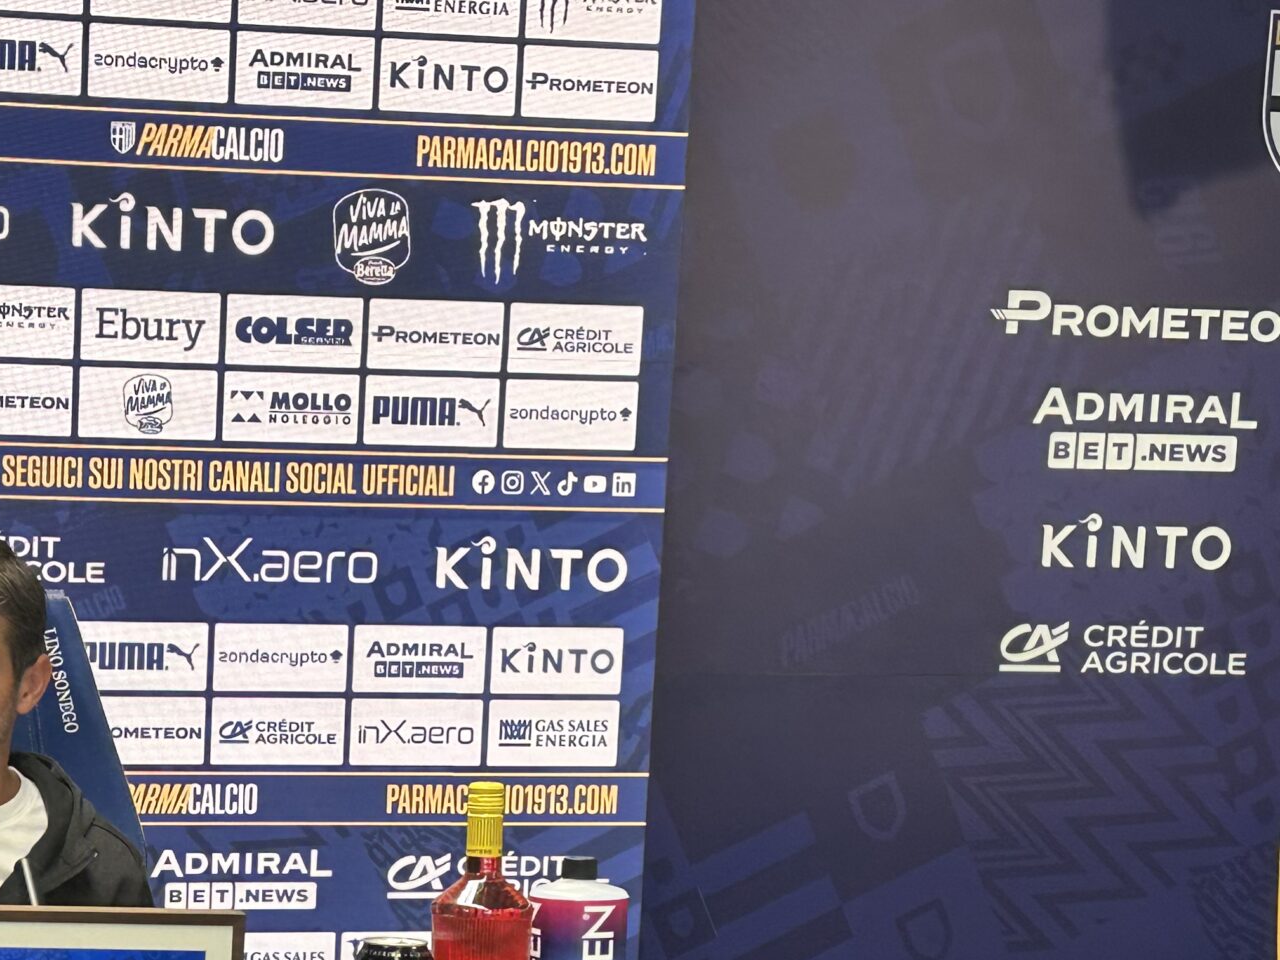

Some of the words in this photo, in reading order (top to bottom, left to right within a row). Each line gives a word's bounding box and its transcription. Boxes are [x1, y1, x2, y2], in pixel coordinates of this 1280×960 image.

[94, 53, 208, 73] zondacrypto
[249, 49, 362, 71] ADMIRAL
[525, 72, 654, 95] PROMETEON
[137, 124, 283, 163] PARMACALCIO
[416, 134, 656, 176] PARMACALCIO1913.COM
[336, 216, 408, 254] MAMMA
[990, 290, 1280, 342] PROMETEO
[95, 308, 206, 351] Ebury
[235, 316, 353, 346] COLSER
[371, 325, 500, 346] PROMETEON
[554, 327, 613, 341] CRÉDIT
[552, 341, 634, 354] AGRICOLE
[269, 391, 351, 411] MOLLO
[373, 396, 461, 427] PUMA
[1032, 387, 1258, 429] ADMIRAL
[269, 414, 351, 426] NOLEGGIO
[509, 405, 617, 423] zondacrypto
[2, 455, 82, 487] SEGUICI
[88, 457, 123, 490] SUI
[130, 459, 202, 490] NOSTRI
[208, 460, 279, 493] CANALI
[286, 462, 358, 494] SOCIAL
[362, 463, 455, 496] UFFICIALI
[1084, 621, 1204, 648] CRÉDIT
[219, 651, 326, 664] zondacrypto
[367, 641, 474, 660] ADMIRAL
[1081, 652, 1246, 675] AGRICOLE
[52, 670, 79, 734] SONEGO
[255, 722, 314, 733] CRÉDIT
[536, 720, 566, 732] GAS
[569, 720, 608, 732] SALES
[255, 735, 337, 745] AGRICOLE
[536, 735, 608, 747] ENERGIA
[386, 784, 618, 814] PARMACIO1913.COM
[152, 849, 333, 877] ADMIRAL
